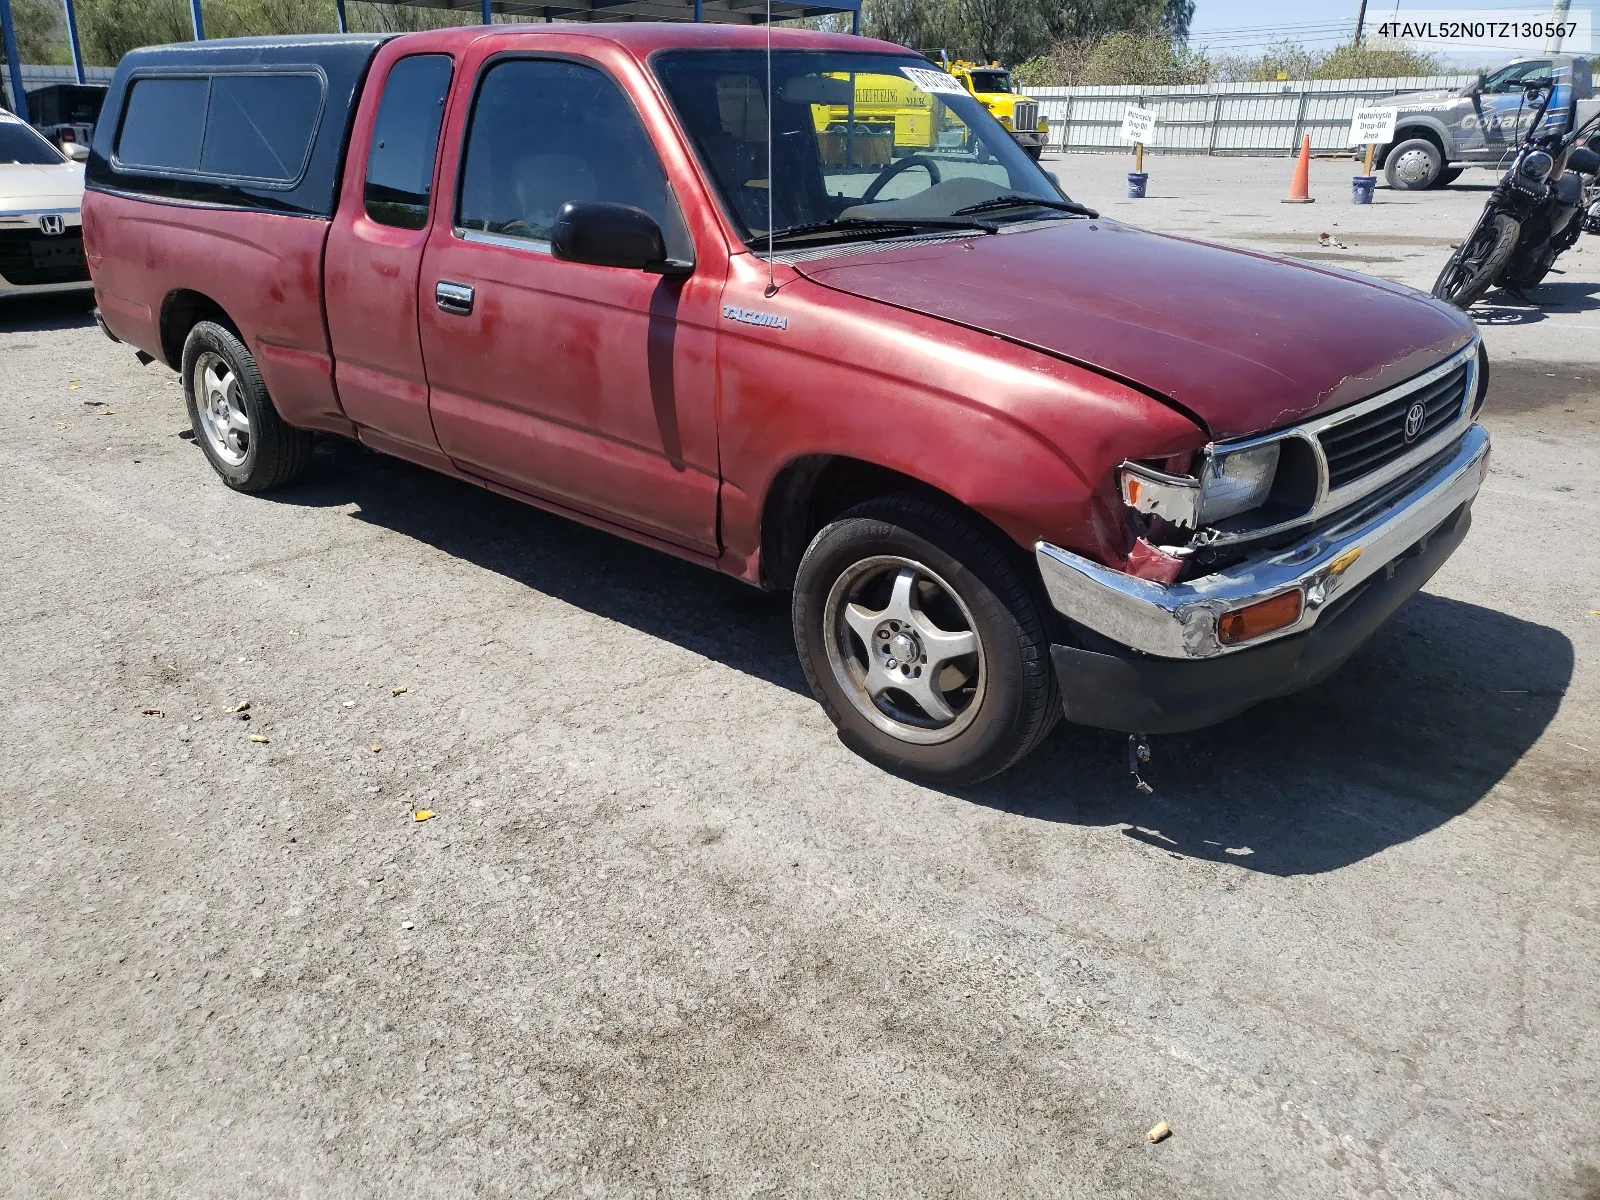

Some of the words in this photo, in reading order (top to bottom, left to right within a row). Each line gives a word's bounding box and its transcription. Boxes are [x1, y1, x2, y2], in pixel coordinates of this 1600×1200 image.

[1128, 111, 1152, 121] Motorcycle
[1358, 111, 1392, 120] Motorcycle
[1360, 121, 1387, 130] Drop-Off
[1460, 111, 1538, 132] Copart
[1364, 131, 1379, 140] Area
[723, 305, 787, 330] TACOMA
